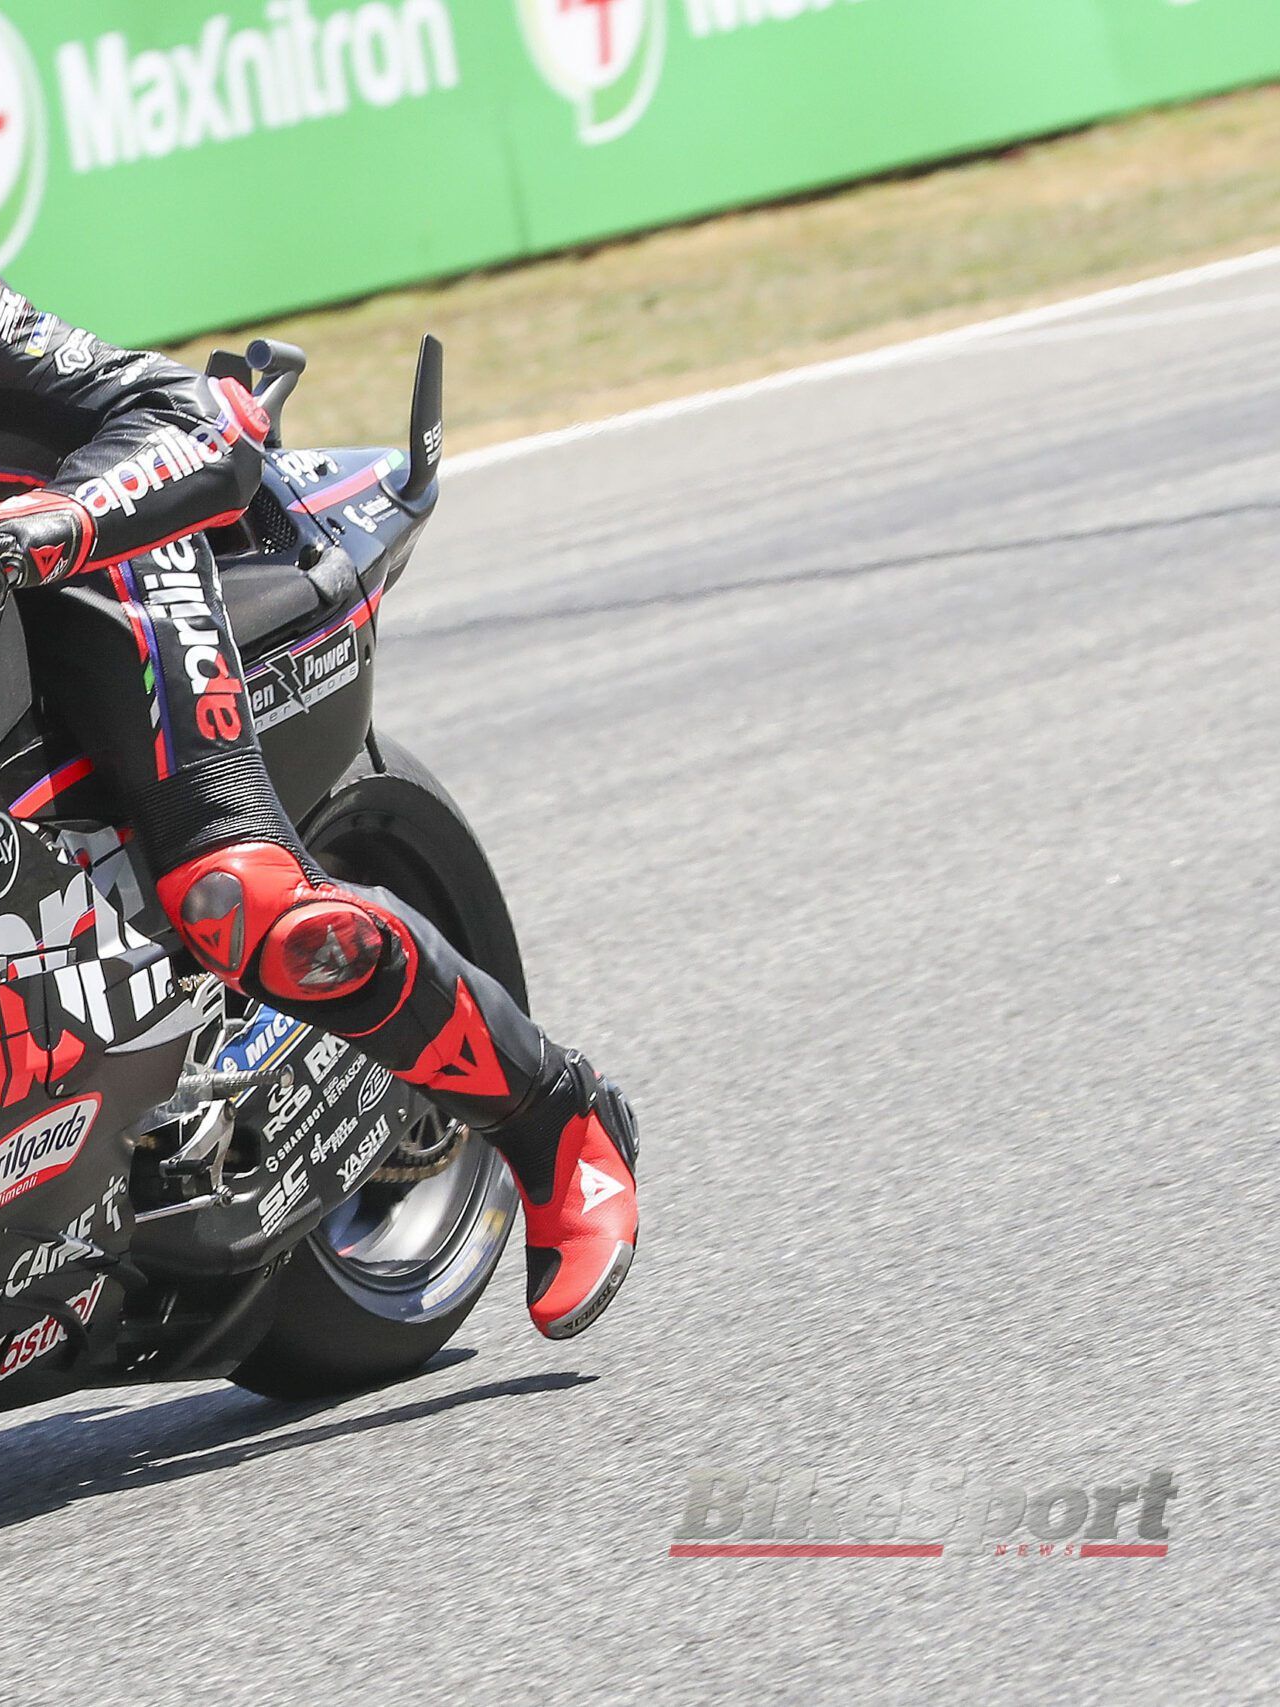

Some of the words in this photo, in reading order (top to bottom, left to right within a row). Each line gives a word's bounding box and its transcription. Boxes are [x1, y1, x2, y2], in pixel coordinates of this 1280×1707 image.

[53, 0, 460, 173] Maxnitron
[75, 423, 233, 517] aprilia
[143, 534, 242, 742] aprilia
[304, 637, 352, 686] Power
[262, 1084, 313, 1143] RCB
[277, 1101, 325, 1160] SHAREBOT
[336, 1114, 388, 1181] YASHI
[258, 1154, 307, 1227] SC
